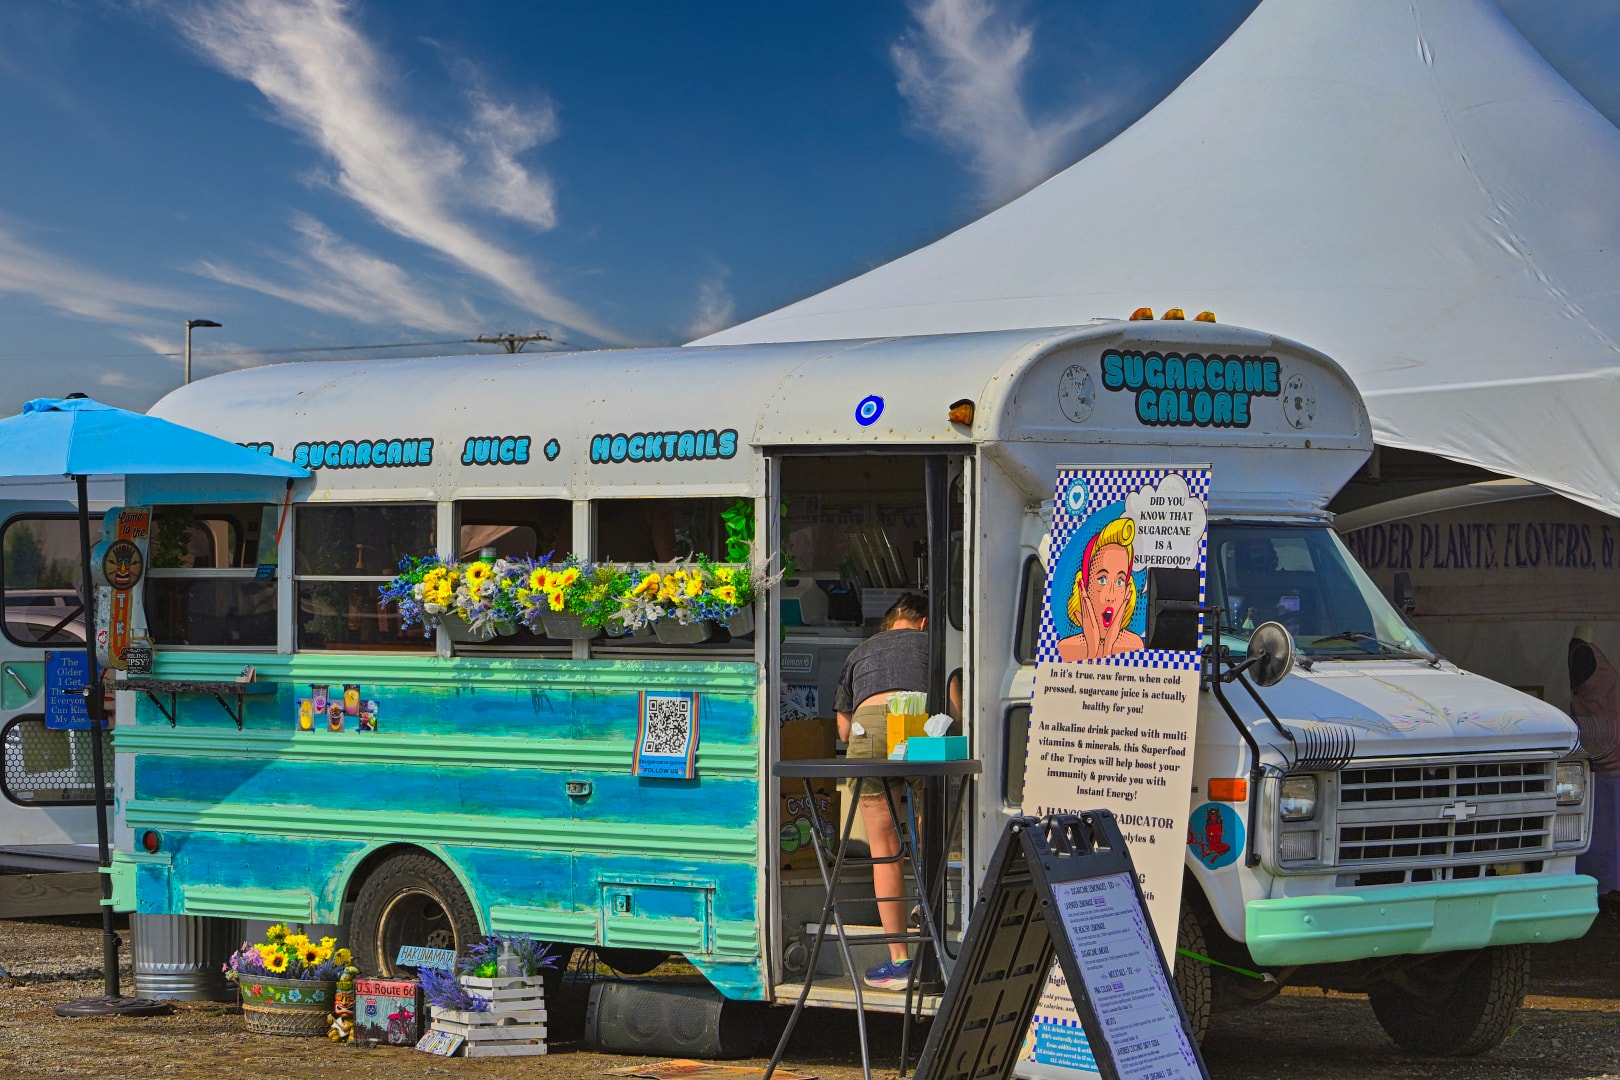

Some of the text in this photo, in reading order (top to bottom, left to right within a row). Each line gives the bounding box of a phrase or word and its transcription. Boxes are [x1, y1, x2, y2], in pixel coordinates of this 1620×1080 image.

[1101, 349, 1281, 397] SUGARCANE
[1135, 388, 1251, 428] GALORE
[293, 438, 434, 470] SUGARCANE
[461, 436, 531, 466] JUICE
[590, 428, 738, 464] MOCKTAILS
[1150, 497, 1186, 506] DID YOU
[1140, 511, 1193, 521] KNOW THAT
[1138, 526, 1191, 536] SUGARCANE
[1155, 540, 1172, 550] IS A
[1134, 555, 1191, 566] SUPERFOOD?
[61, 657, 79, 667] The
[57, 668, 83, 677] Older
[1050, 668, 1058, 678] In
[1059, 669, 1073, 679] it's
[1097, 673, 1112, 681] raw
[1138, 673, 1161, 684] when
[51, 697, 85, 706] Everyon
[1078, 687, 1118, 697] sugarcane
[1120, 688, 1140, 699] juice
[1142, 689, 1149, 699] is
[1151, 691, 1187, 703] actually
[1082, 701, 1144, 715] healthy for you!
[55, 715, 68, 724] My
[1038, 721, 1050, 731] An
[1051, 722, 1085, 733] alkaline
[1087, 725, 1109, 735] drink
[1110, 726, 1138, 737] packed
[1141, 728, 1160, 739] with
[1039, 736, 1075, 748] vitamins
[1077, 739, 1083, 749] &
[1123, 743, 1139, 753] this
[1141, 743, 1186, 757] Superfood
[1040, 752, 1181, 772] of the Tropics will help boost your
[1047, 767, 1166, 787] immunity & provide you with
[1076, 786, 1138, 801] Instant Energy!
[1036, 806, 1043, 816] A
[1113, 814, 1174, 830] RADICATOR
[1122, 834, 1156, 845] olytes &
[374, 983, 401, 996] Route
[403, 985, 415, 996] 66
